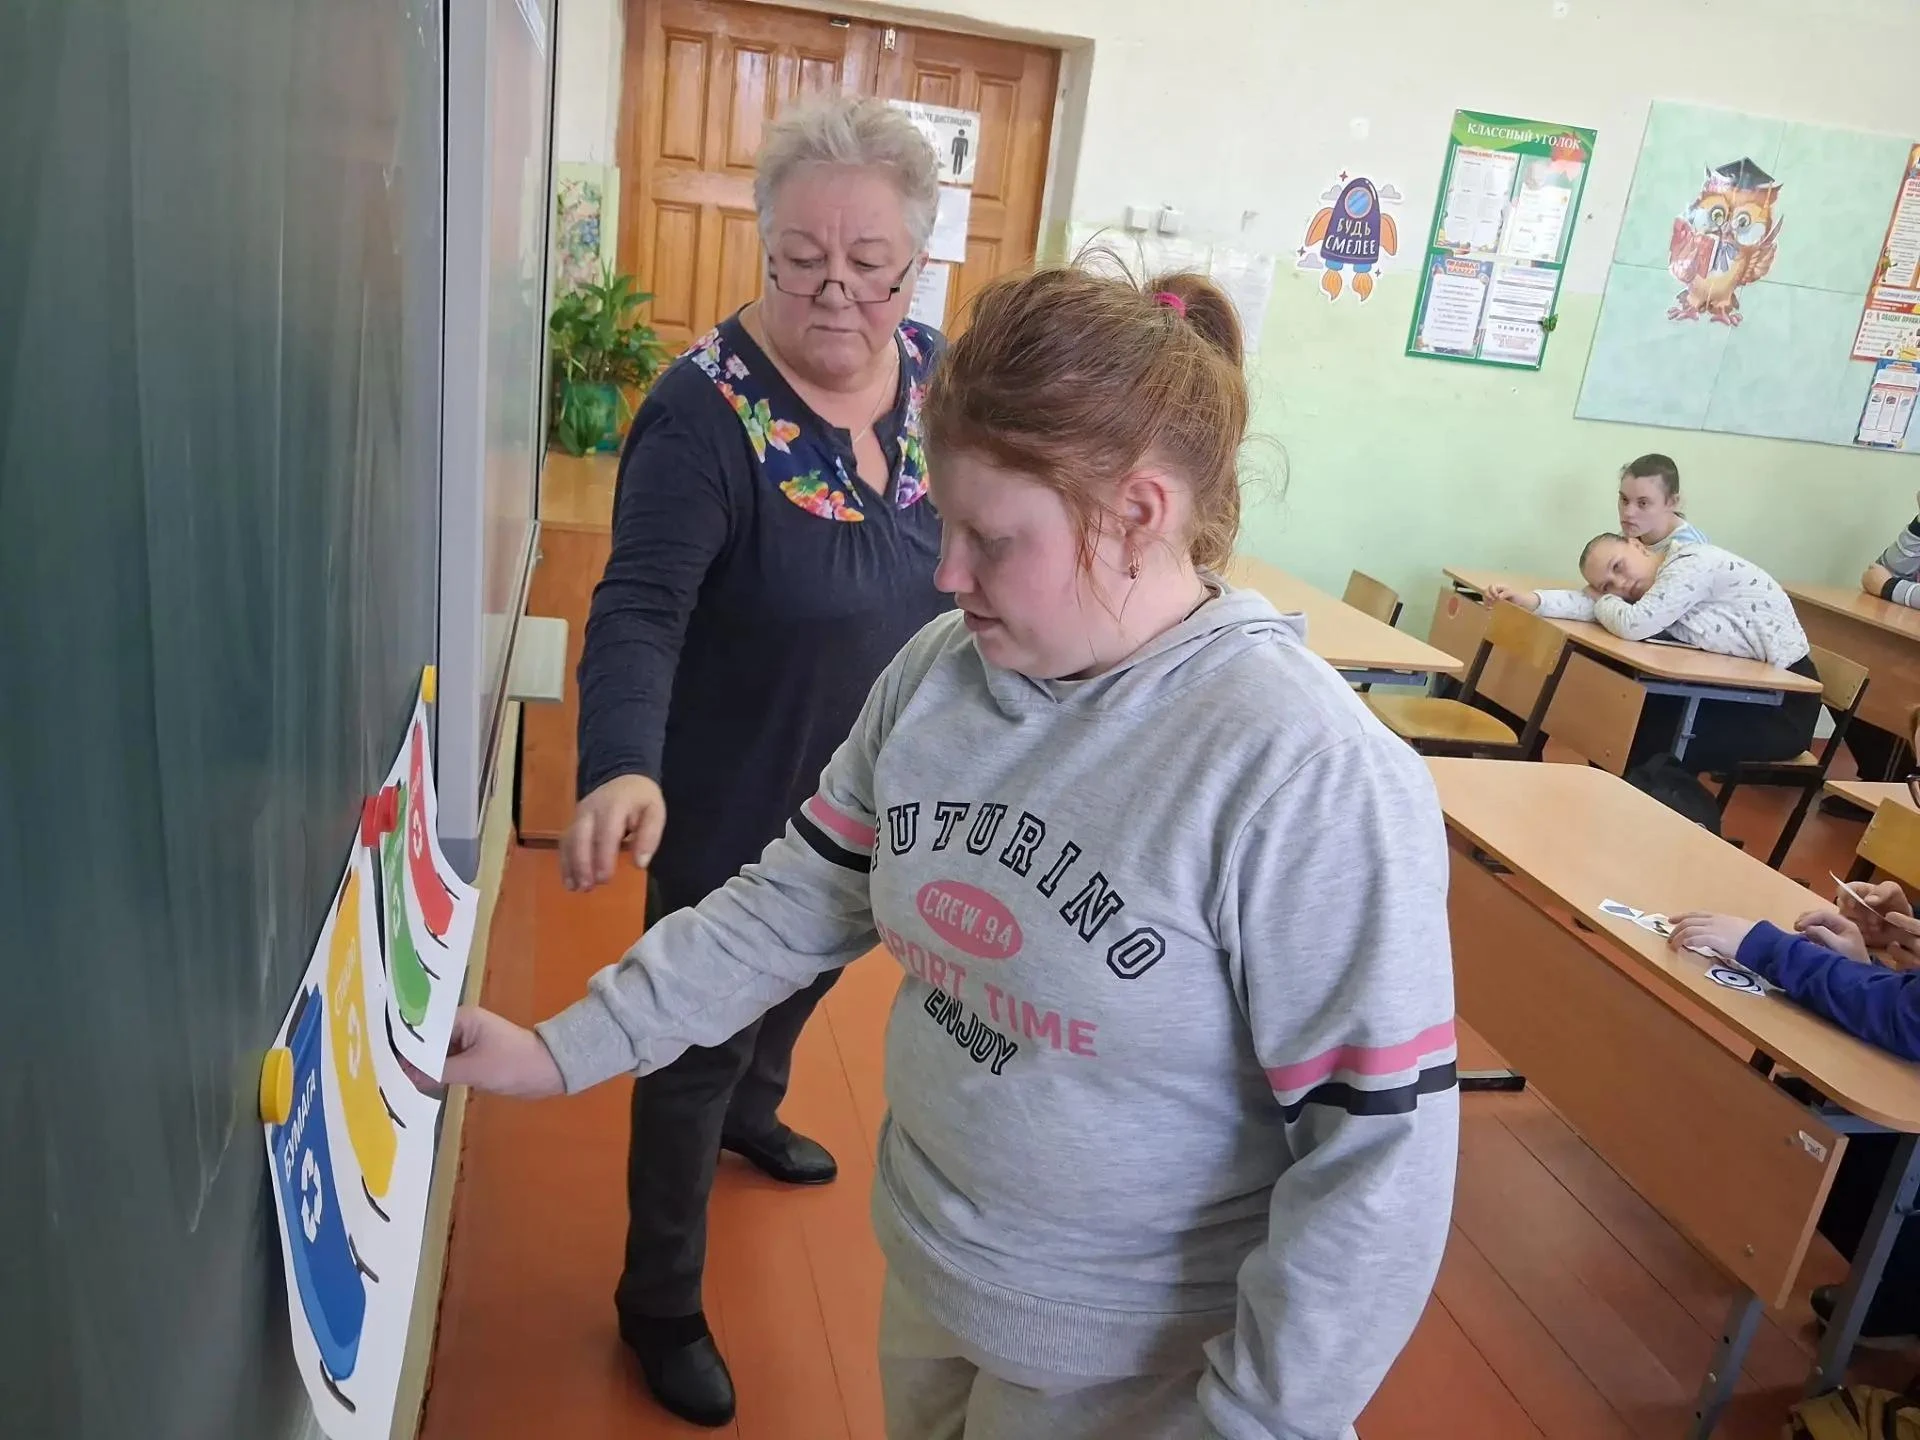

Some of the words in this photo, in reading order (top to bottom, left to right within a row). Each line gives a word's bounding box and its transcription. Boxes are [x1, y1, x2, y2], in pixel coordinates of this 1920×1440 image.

[1467, 122, 1533, 142] КЛАССНЫЙ
[1535, 133, 1581, 150] УГОЛОК
[1325, 234, 1376, 255] СМЕЛЕЕ
[1336, 217, 1371, 238] БУДЬ
[872, 801, 1166, 980] UTURINO
[922, 887, 1013, 953] CREW.94
[923, 987, 1019, 1076] ENJOY
[984, 983, 1098, 1058] TIME
[284, 1067, 316, 1182] БУМАГА
